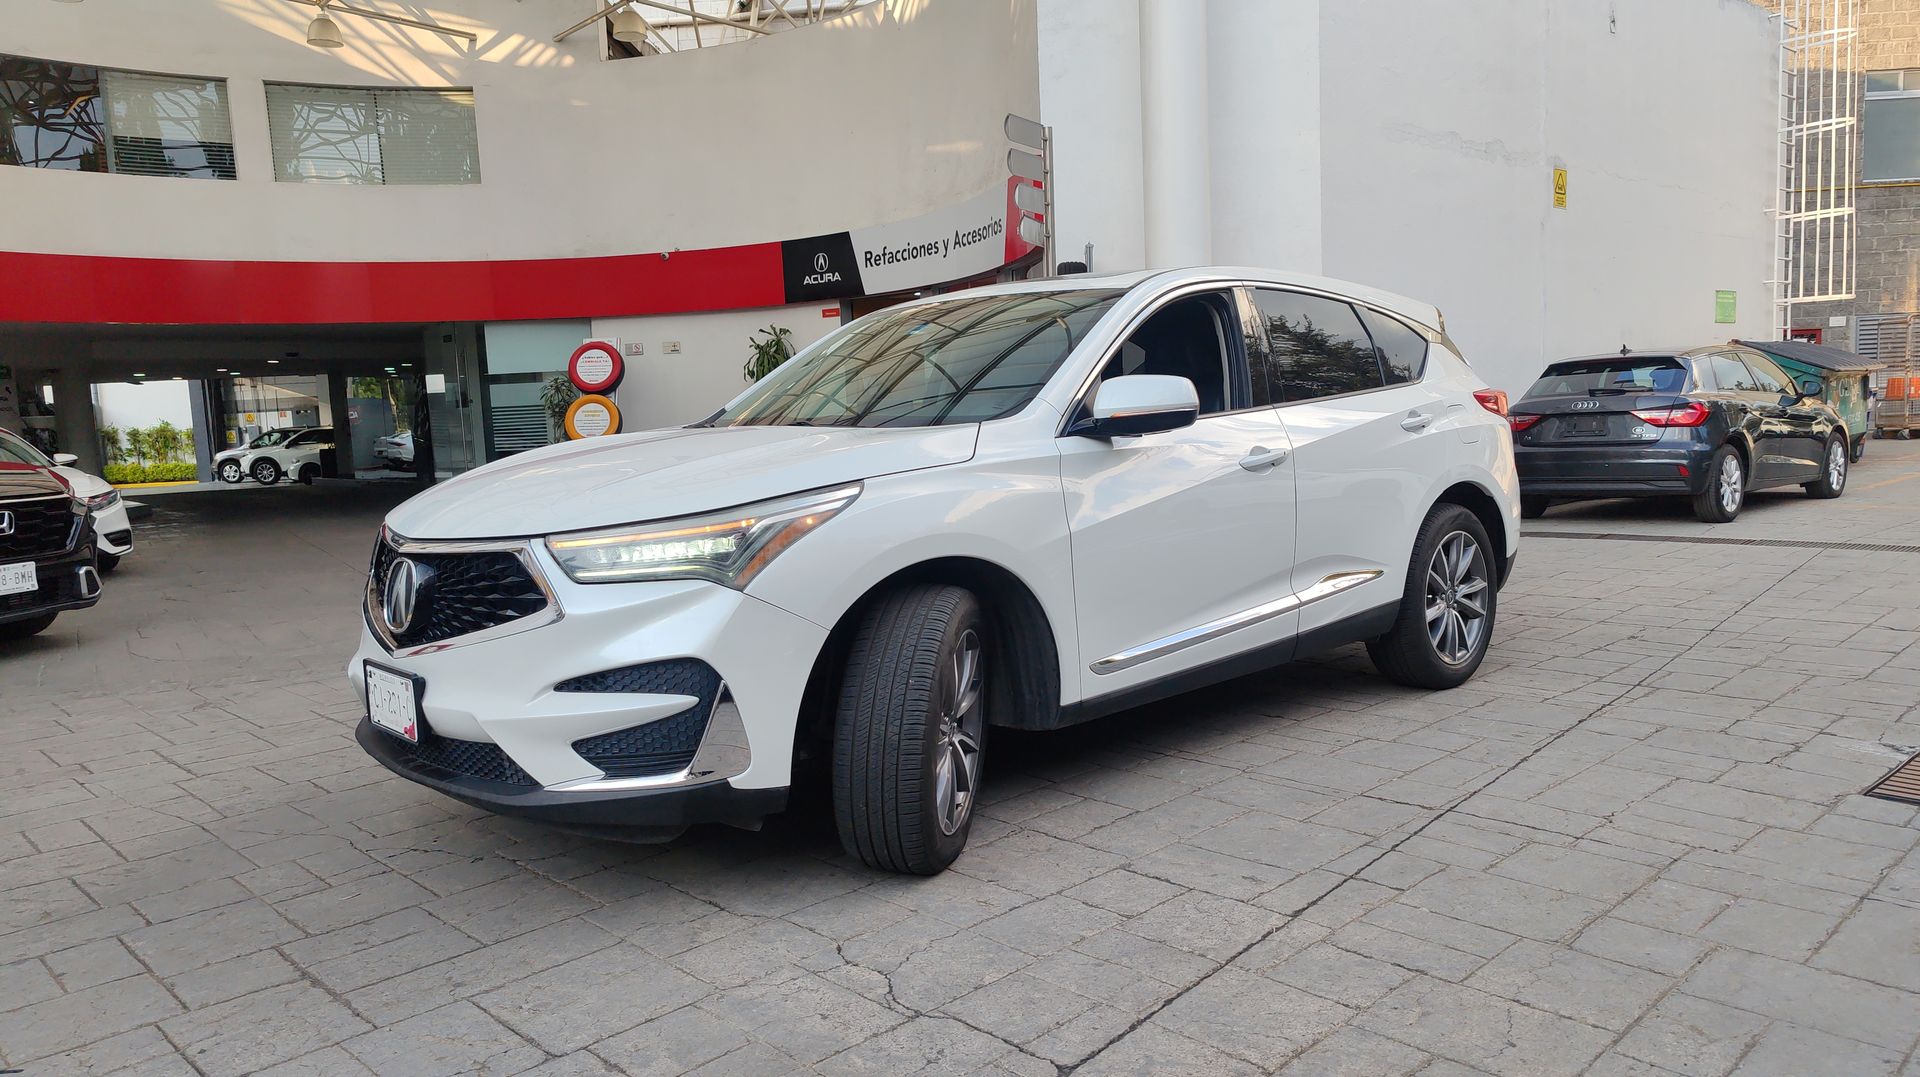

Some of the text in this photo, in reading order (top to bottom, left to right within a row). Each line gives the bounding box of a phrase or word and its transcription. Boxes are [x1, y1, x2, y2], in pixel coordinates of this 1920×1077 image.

[864, 216, 1003, 268] Refacciones y Accesorios
[803, 271, 842, 285] ACURA
